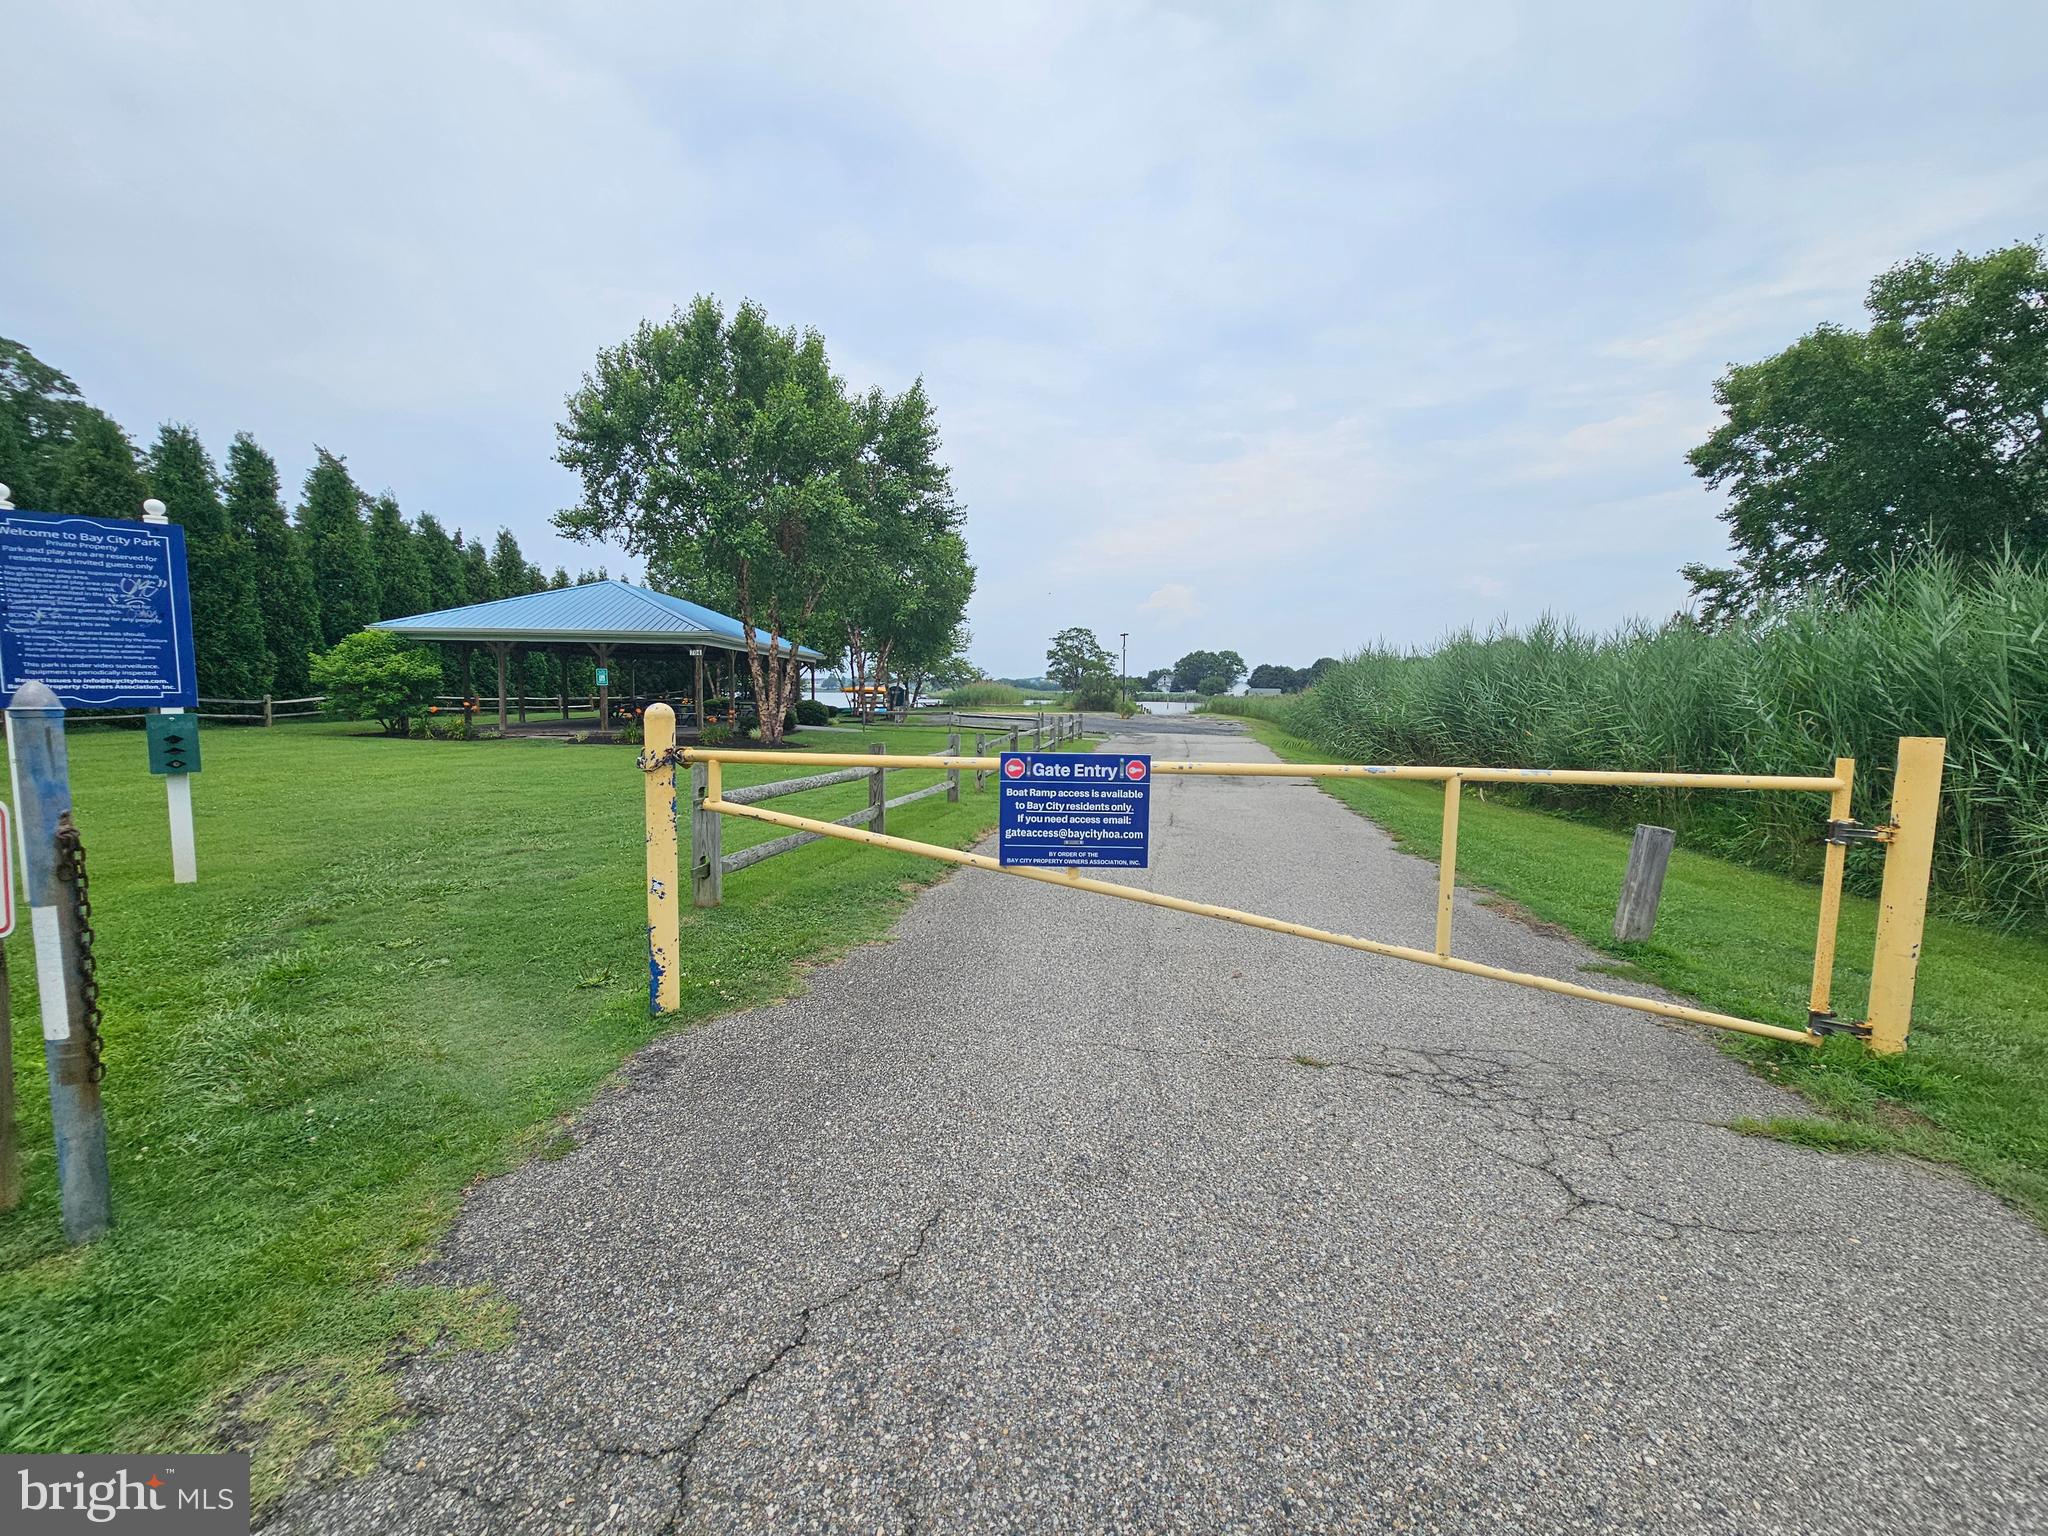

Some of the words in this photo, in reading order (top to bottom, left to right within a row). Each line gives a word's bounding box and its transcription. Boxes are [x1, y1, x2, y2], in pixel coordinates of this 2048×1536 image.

[80, 533, 103, 544] Bay
[107, 536, 130, 546] City
[134, 537, 160, 547] Park
[80, 542, 118, 552] Property
[1033, 763, 1070, 777] Gate
[1074, 764, 1118, 781] Entry
[1006, 788, 1028, 797] Boat
[1030, 789, 1056, 799] Ramp
[1092, 789, 1099, 797] is
[1101, 789, 1143, 798] available
[1027, 802, 1044, 811] Bay
[1046, 802, 1064, 812] City
[1066, 802, 1109, 811] residents
[1111, 803, 1134, 812] only.
[1045, 815, 1068, 824] need
[1103, 816, 1131, 824] email:
[1005, 828, 1143, 840] gateaccess@baycityhoa.com
